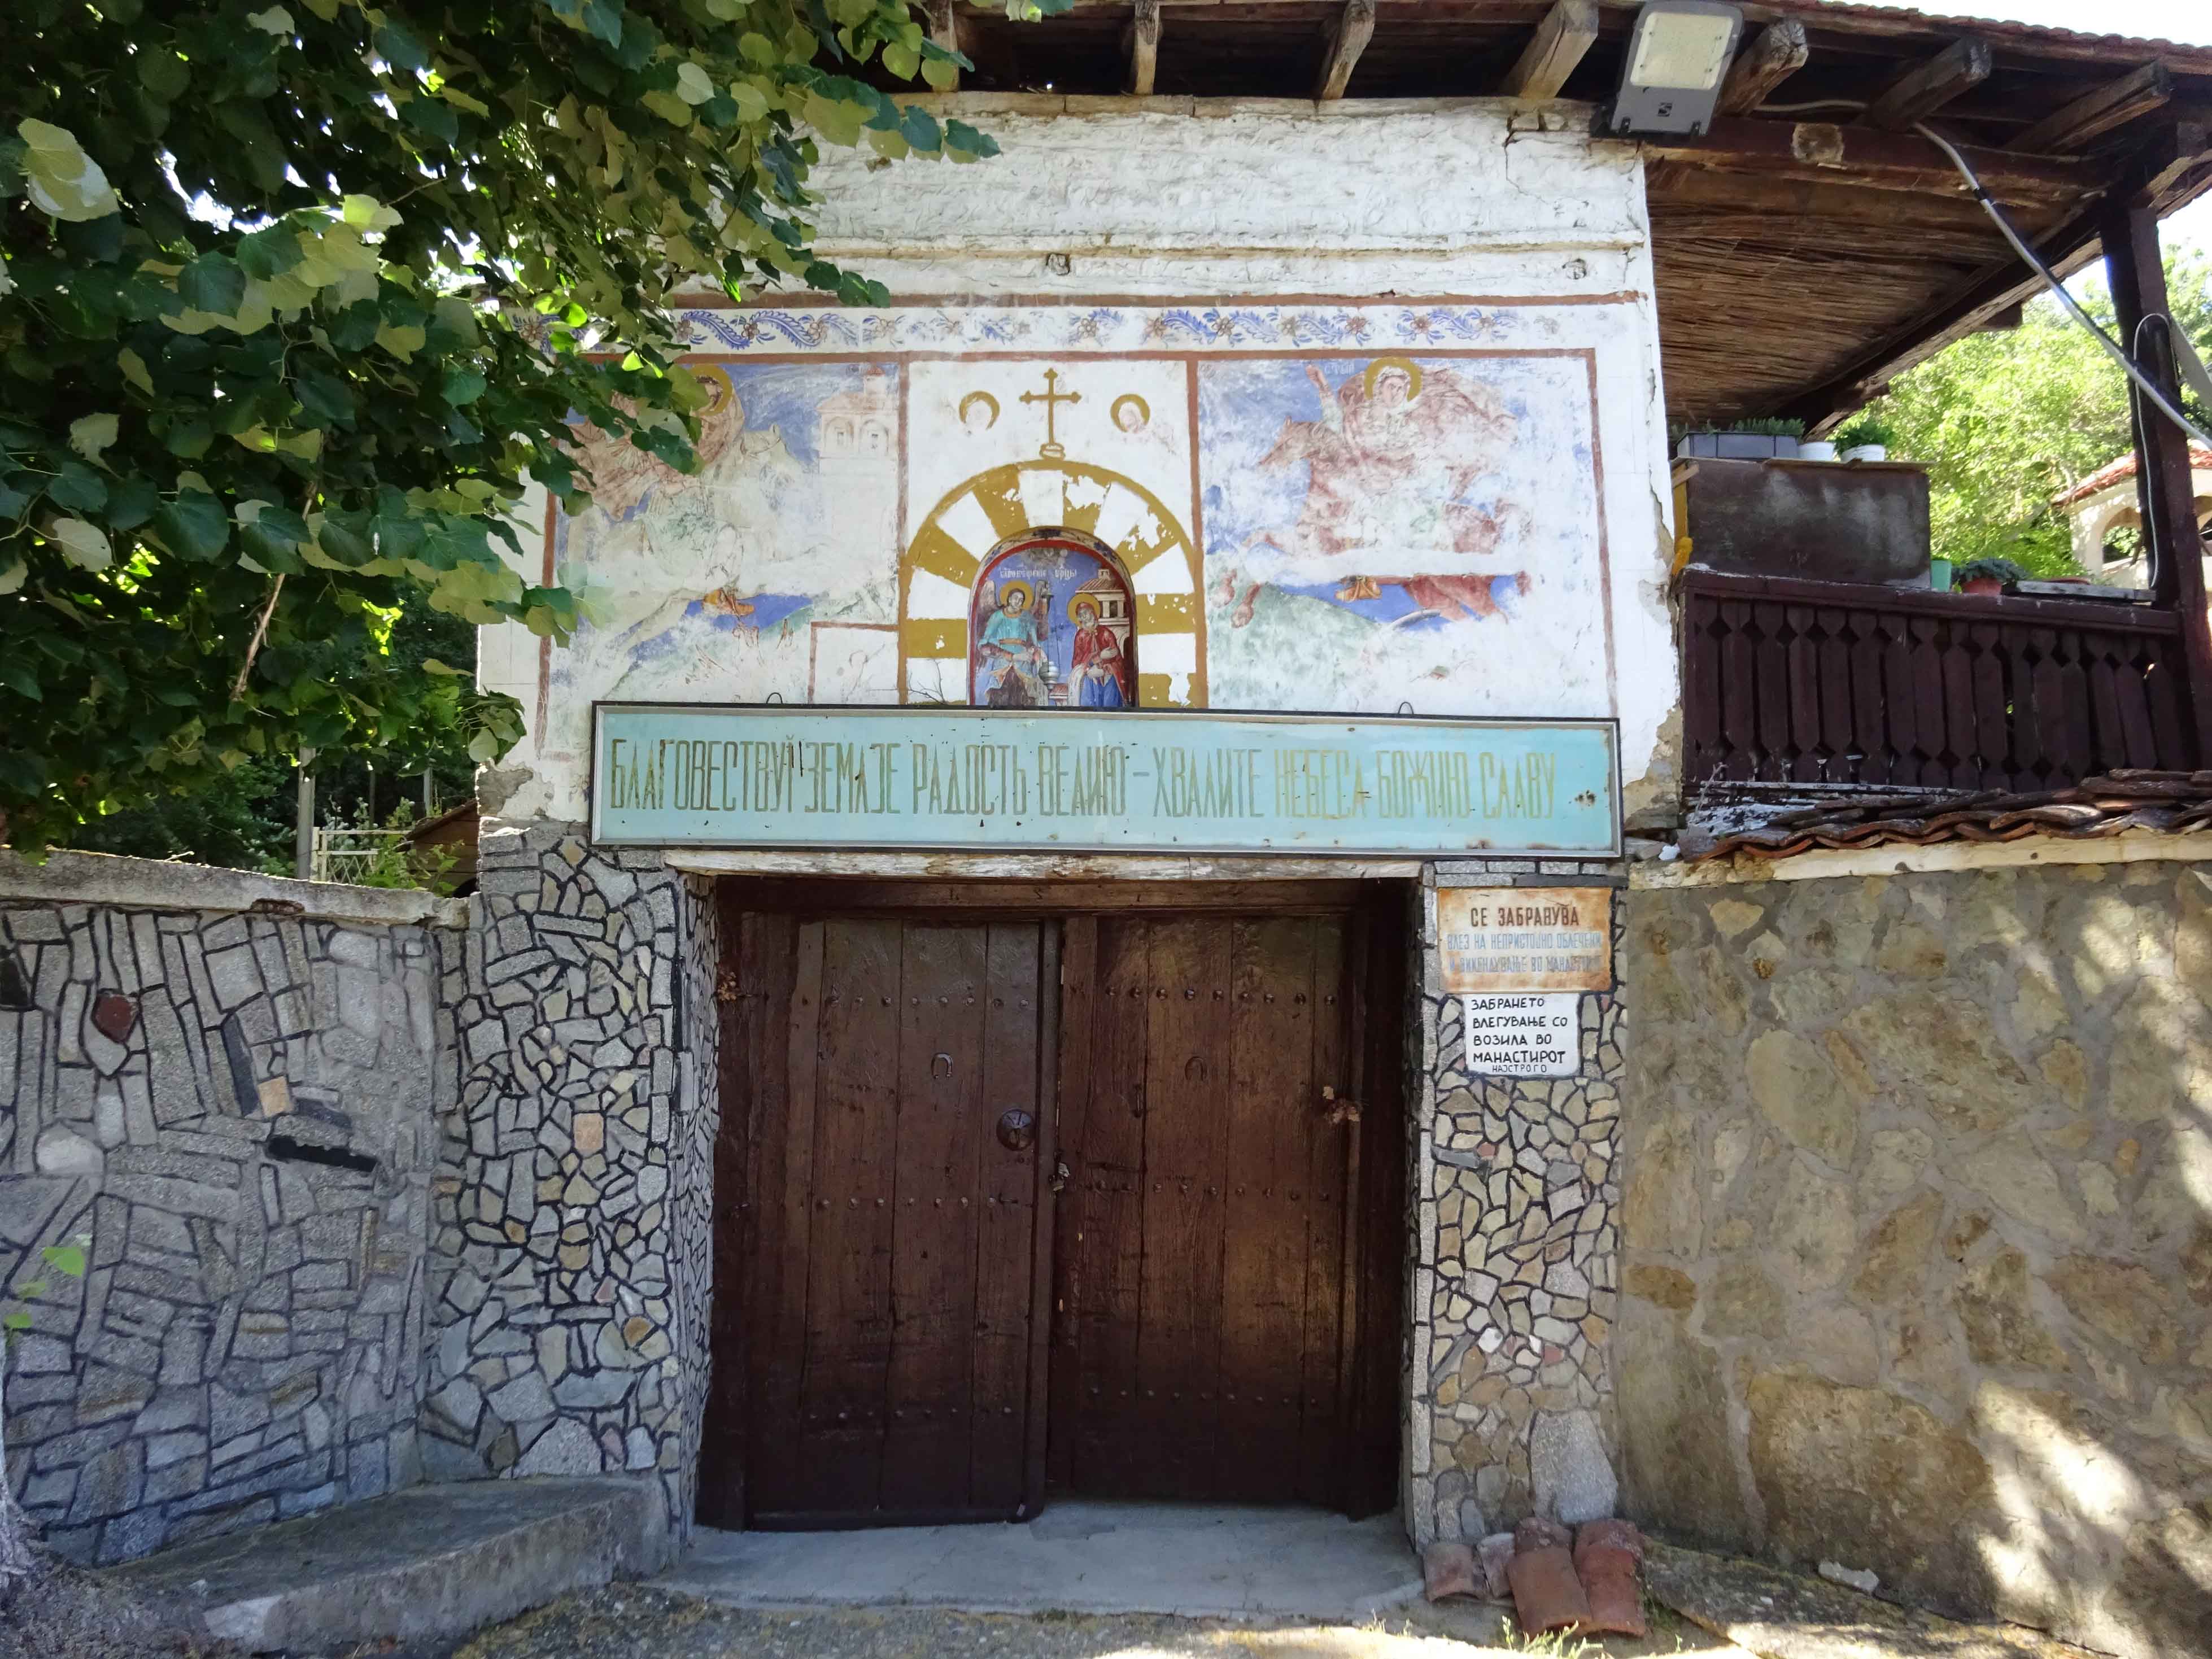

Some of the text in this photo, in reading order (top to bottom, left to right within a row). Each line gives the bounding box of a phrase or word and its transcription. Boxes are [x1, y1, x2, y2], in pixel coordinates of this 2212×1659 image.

[912, 743, 1027, 815] РАДОСТЬ
[1152, 746, 1265, 819] ХВАЛИТЕ
[1273, 749, 1368, 819] НЕБЕСА
[1376, 750, 1469, 819] БОЖИЮ
[1479, 751, 1556, 819] СЛАВУ
[1471, 907, 1487, 927] СЕ
[1474, 934, 1486, 949] НА
[1472, 1016, 1568, 1029] ВЛЕГУВАЊЕ СО
[1473, 1034, 1552, 1046] ВОЗИЛА ВО
[1473, 1051, 1566, 1064] МАНАСТИРОТ
